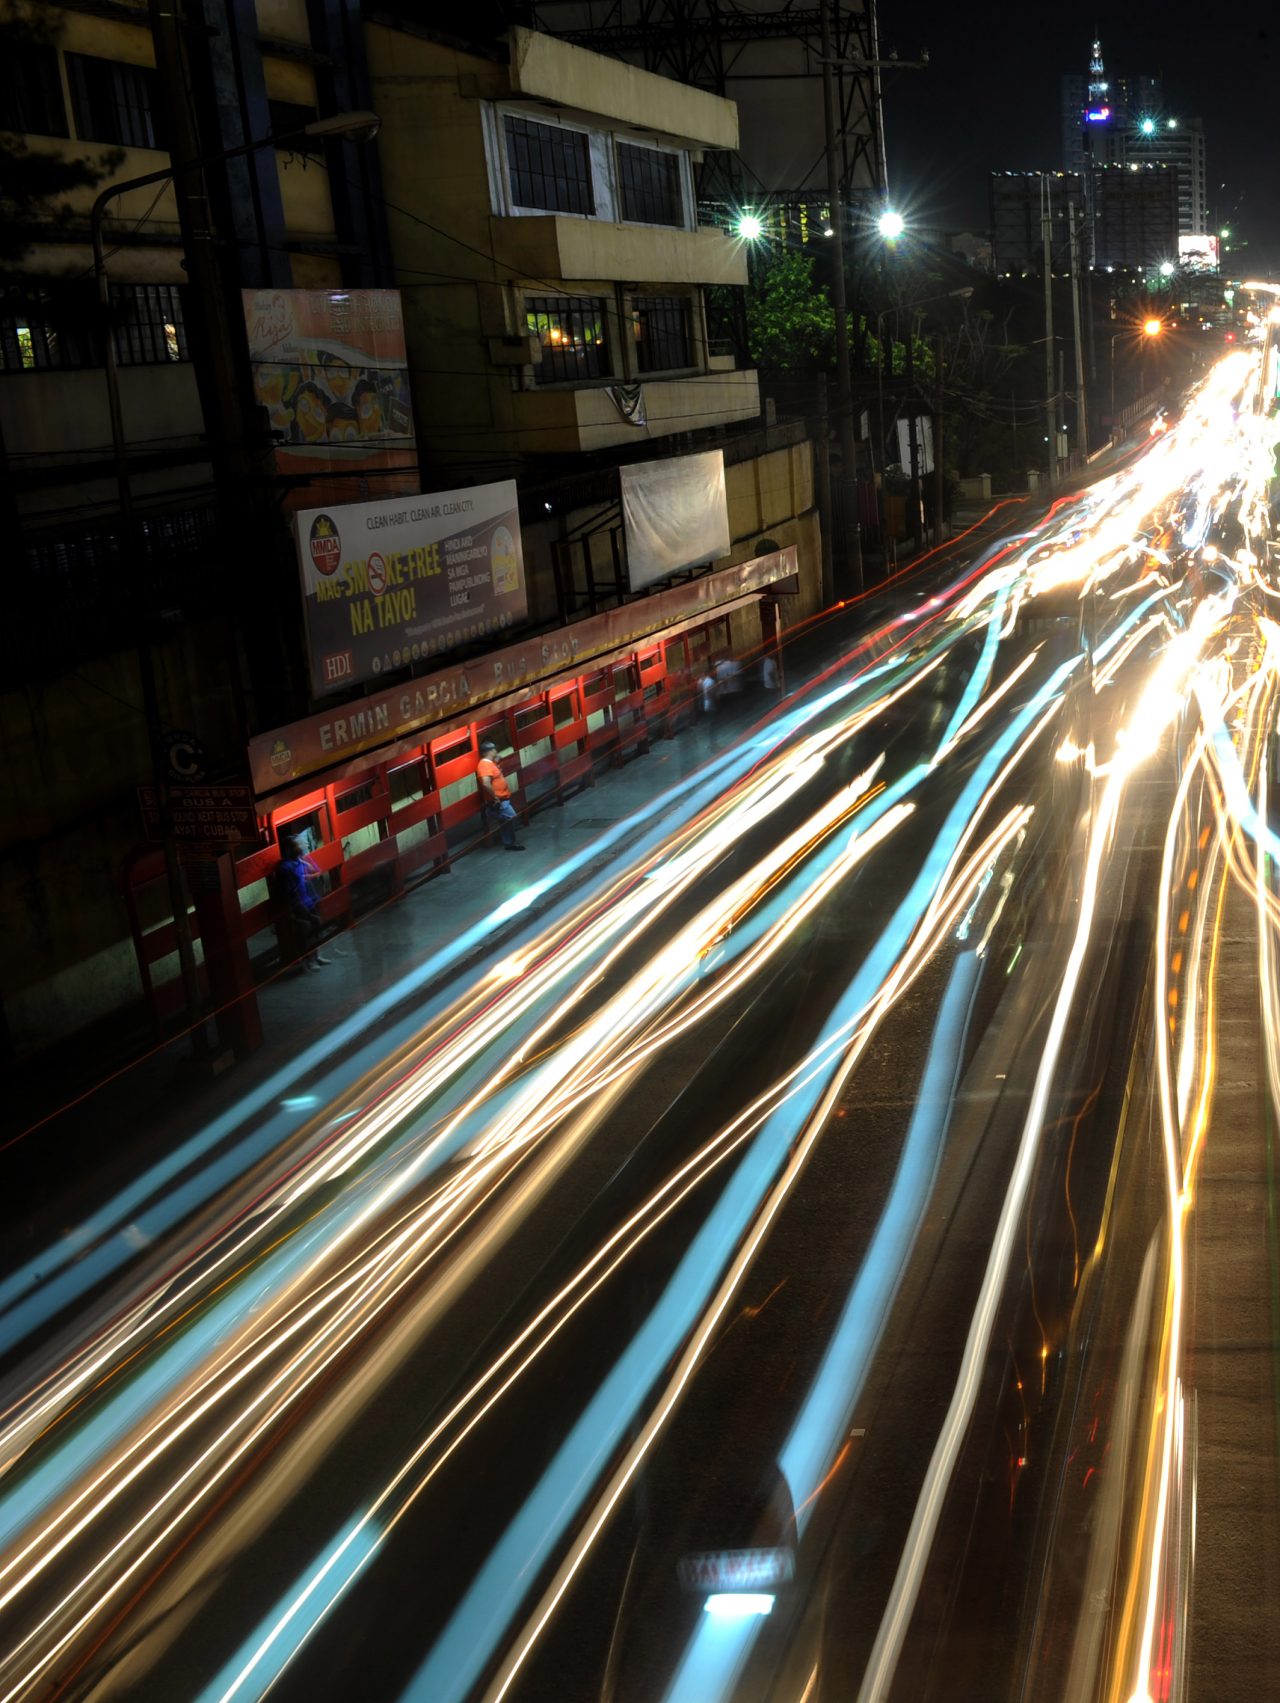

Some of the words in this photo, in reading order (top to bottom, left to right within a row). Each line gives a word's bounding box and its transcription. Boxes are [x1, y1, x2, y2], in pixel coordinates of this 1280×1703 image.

[366, 515, 389, 530] CLEAN
[389, 511, 410, 527] HABIT.
[410, 507, 431, 522] CLEAN
[443, 501, 461, 516] CLEAN
[312, 538, 340, 556] MMDA
[350, 599, 374, 636] NA
[374, 586, 417, 628] TAYO!
[325, 653, 351, 679] HDI
[319, 703, 389, 751] ERMIN
[399, 673, 471, 719] GARCIA
[182, 798, 215, 807] BUS
[221, 798, 233, 806] A
